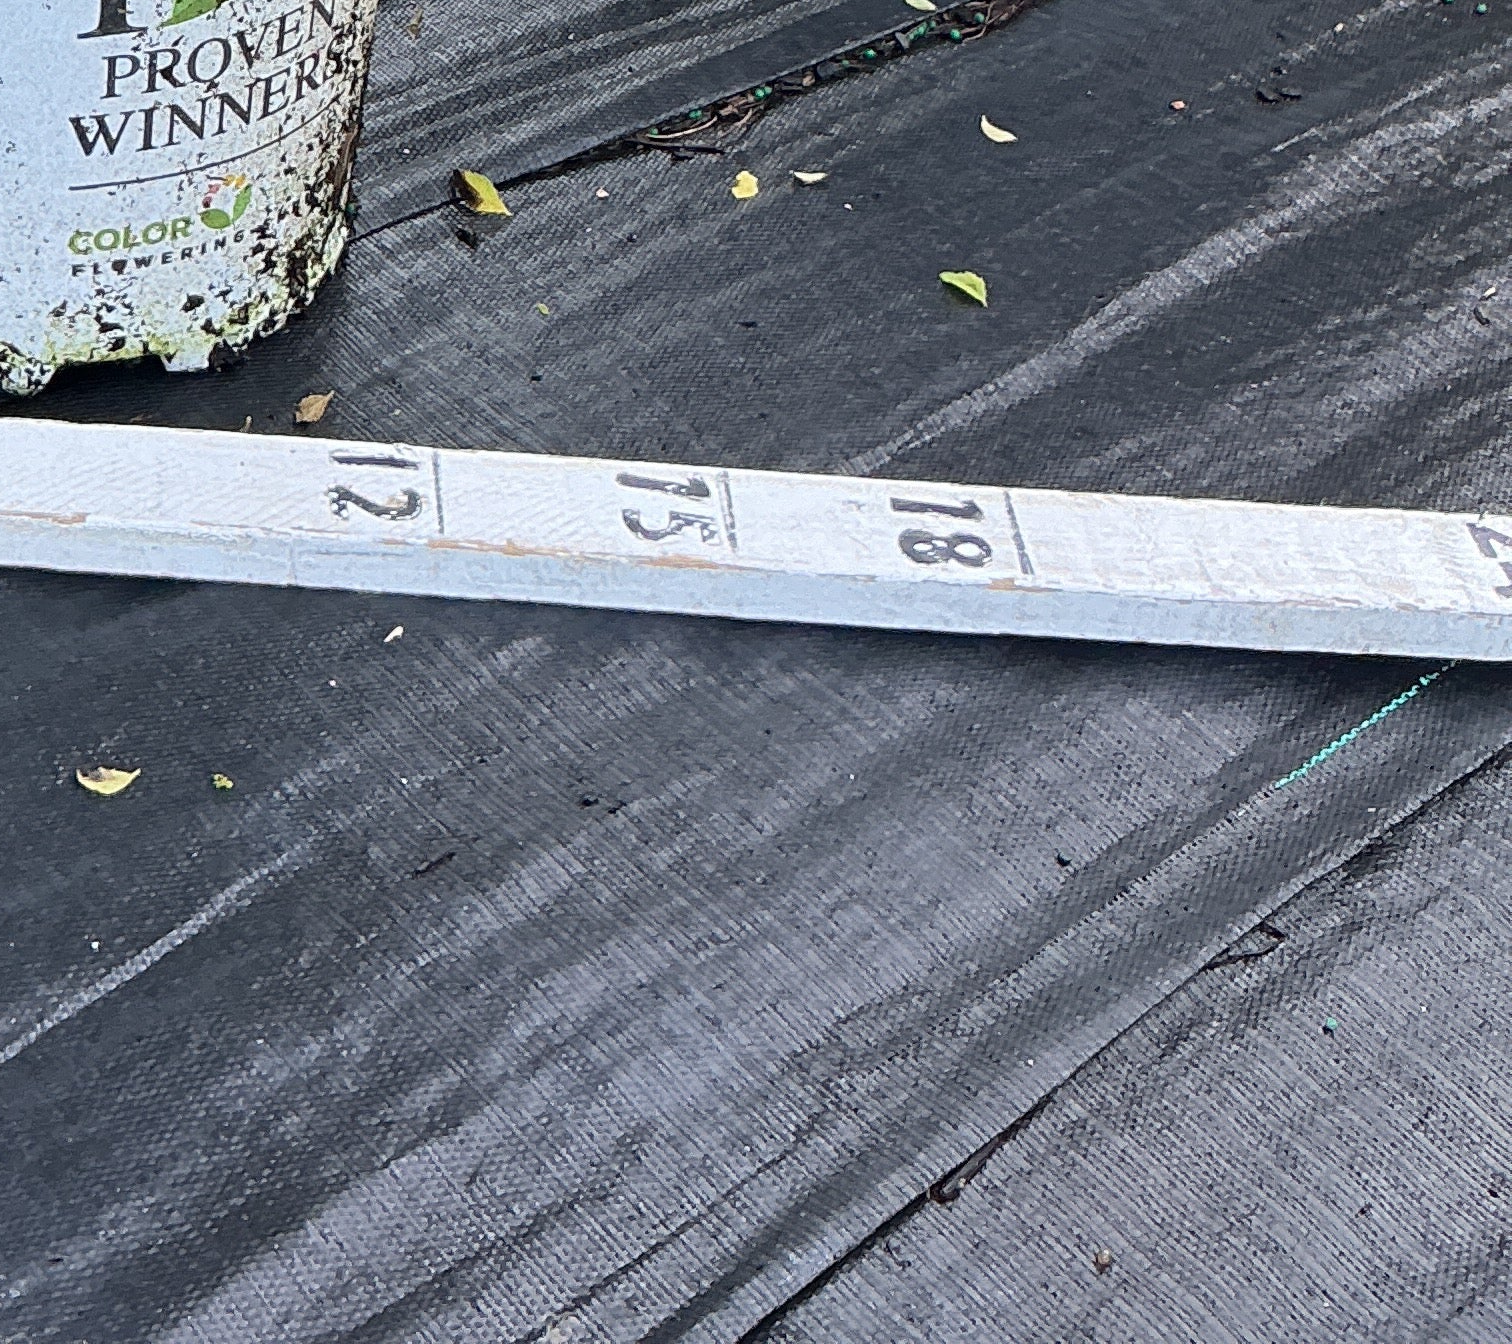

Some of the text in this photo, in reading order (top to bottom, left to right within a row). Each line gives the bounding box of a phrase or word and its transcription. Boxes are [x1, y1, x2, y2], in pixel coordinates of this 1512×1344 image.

[67, 215, 192, 255] COLOR
[71, 229, 245, 277] FLOWERING
[326, 454, 422, 520] 12
[615, 472, 719, 542] 15
[890, 496, 992, 568] 18
